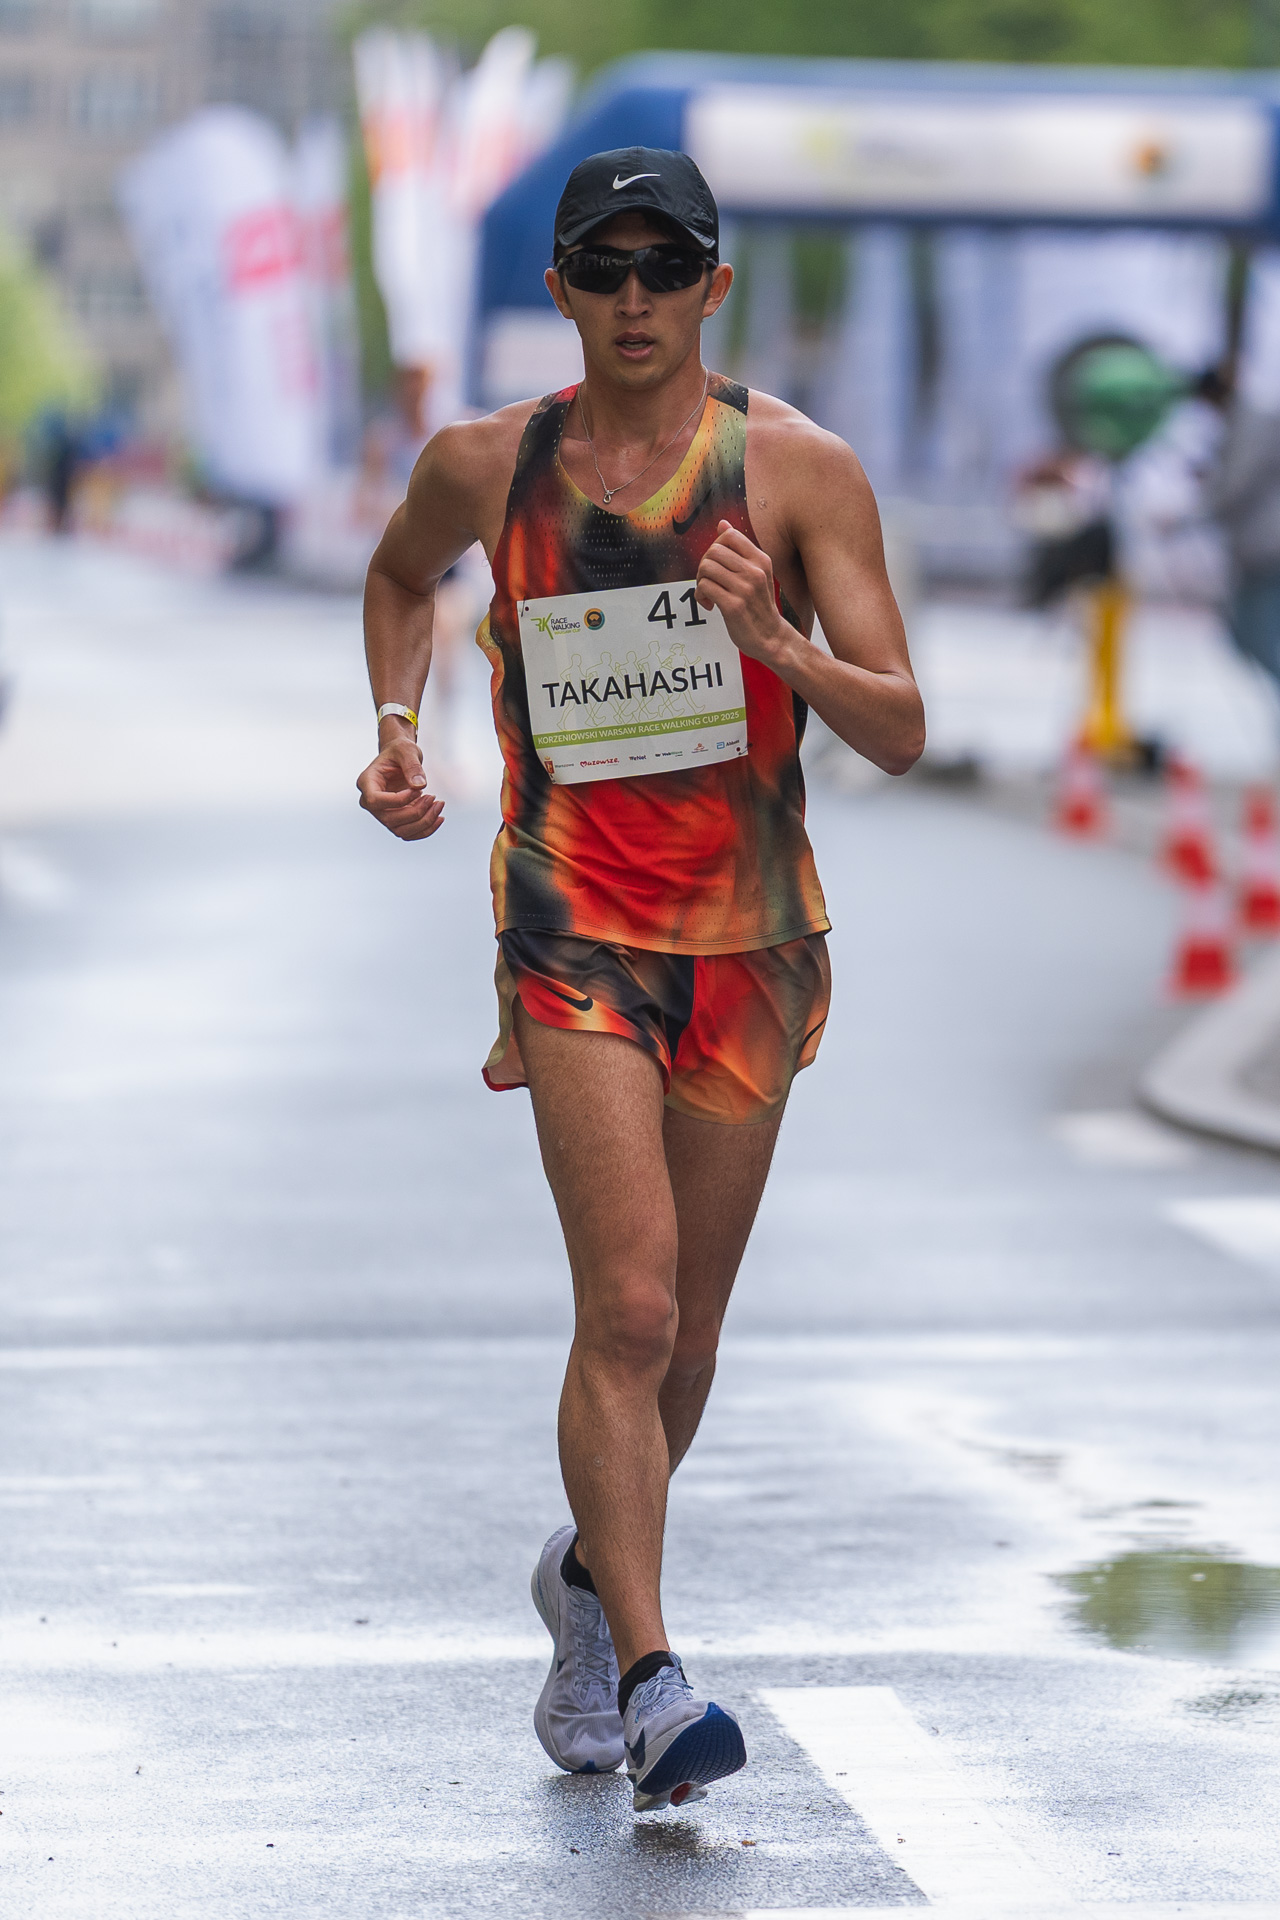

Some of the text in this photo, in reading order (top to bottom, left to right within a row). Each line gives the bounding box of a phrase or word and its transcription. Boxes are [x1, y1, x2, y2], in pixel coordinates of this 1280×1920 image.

[551, 622, 581, 631] WALKING
[647, 587, 707, 629] 41
[542, 662, 723, 708] TAKAHASHI
[537, 711, 740, 744] KORZENIOWSKI WARSAW RACE WALKING CUP 2025
